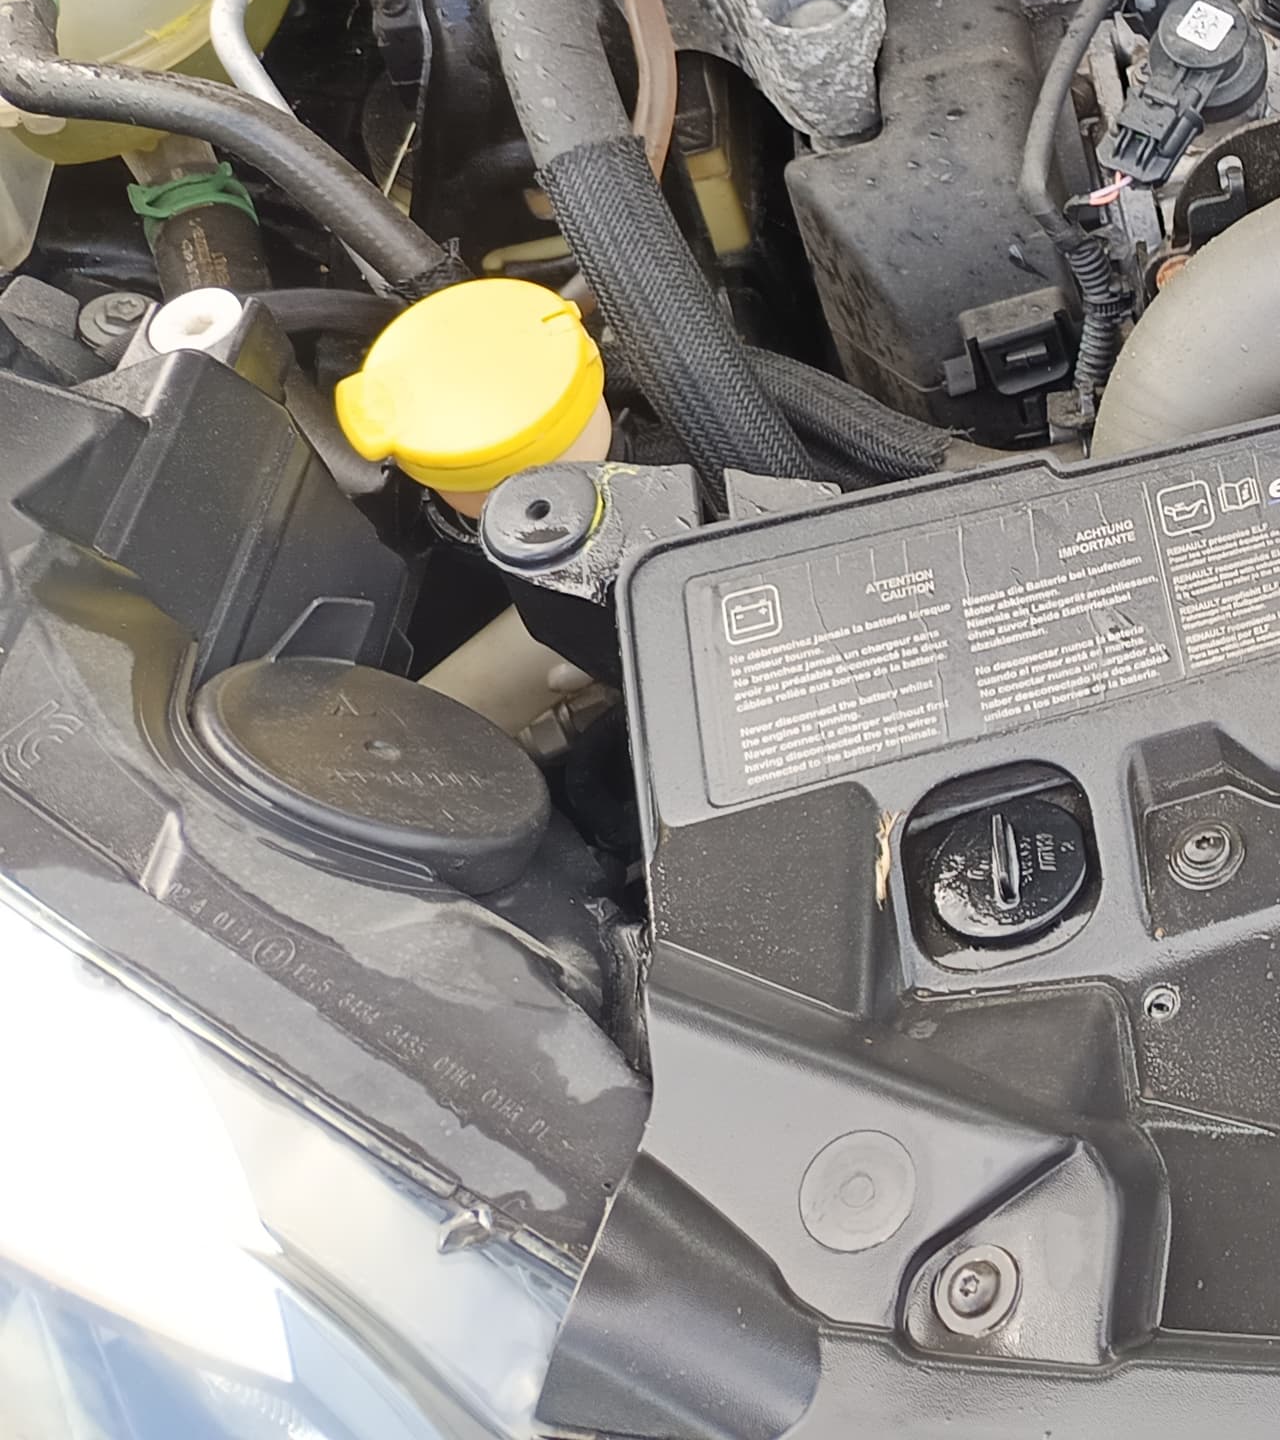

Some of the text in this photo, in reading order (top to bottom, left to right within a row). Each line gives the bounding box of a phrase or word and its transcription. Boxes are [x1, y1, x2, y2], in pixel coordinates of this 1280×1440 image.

[1075, 519, 1134, 542] ACHTUNG
[1059, 531, 1137, 558] IMPORTANTE
[1166, 539, 1207, 555] RENAULT
[865, 569, 933, 594] ATTENTION
[881, 581, 935, 603] CAUTION
[741, 679, 932, 736] Never disconnect the battery whilst
[745, 716, 937, 773] having disconnected the two wires
